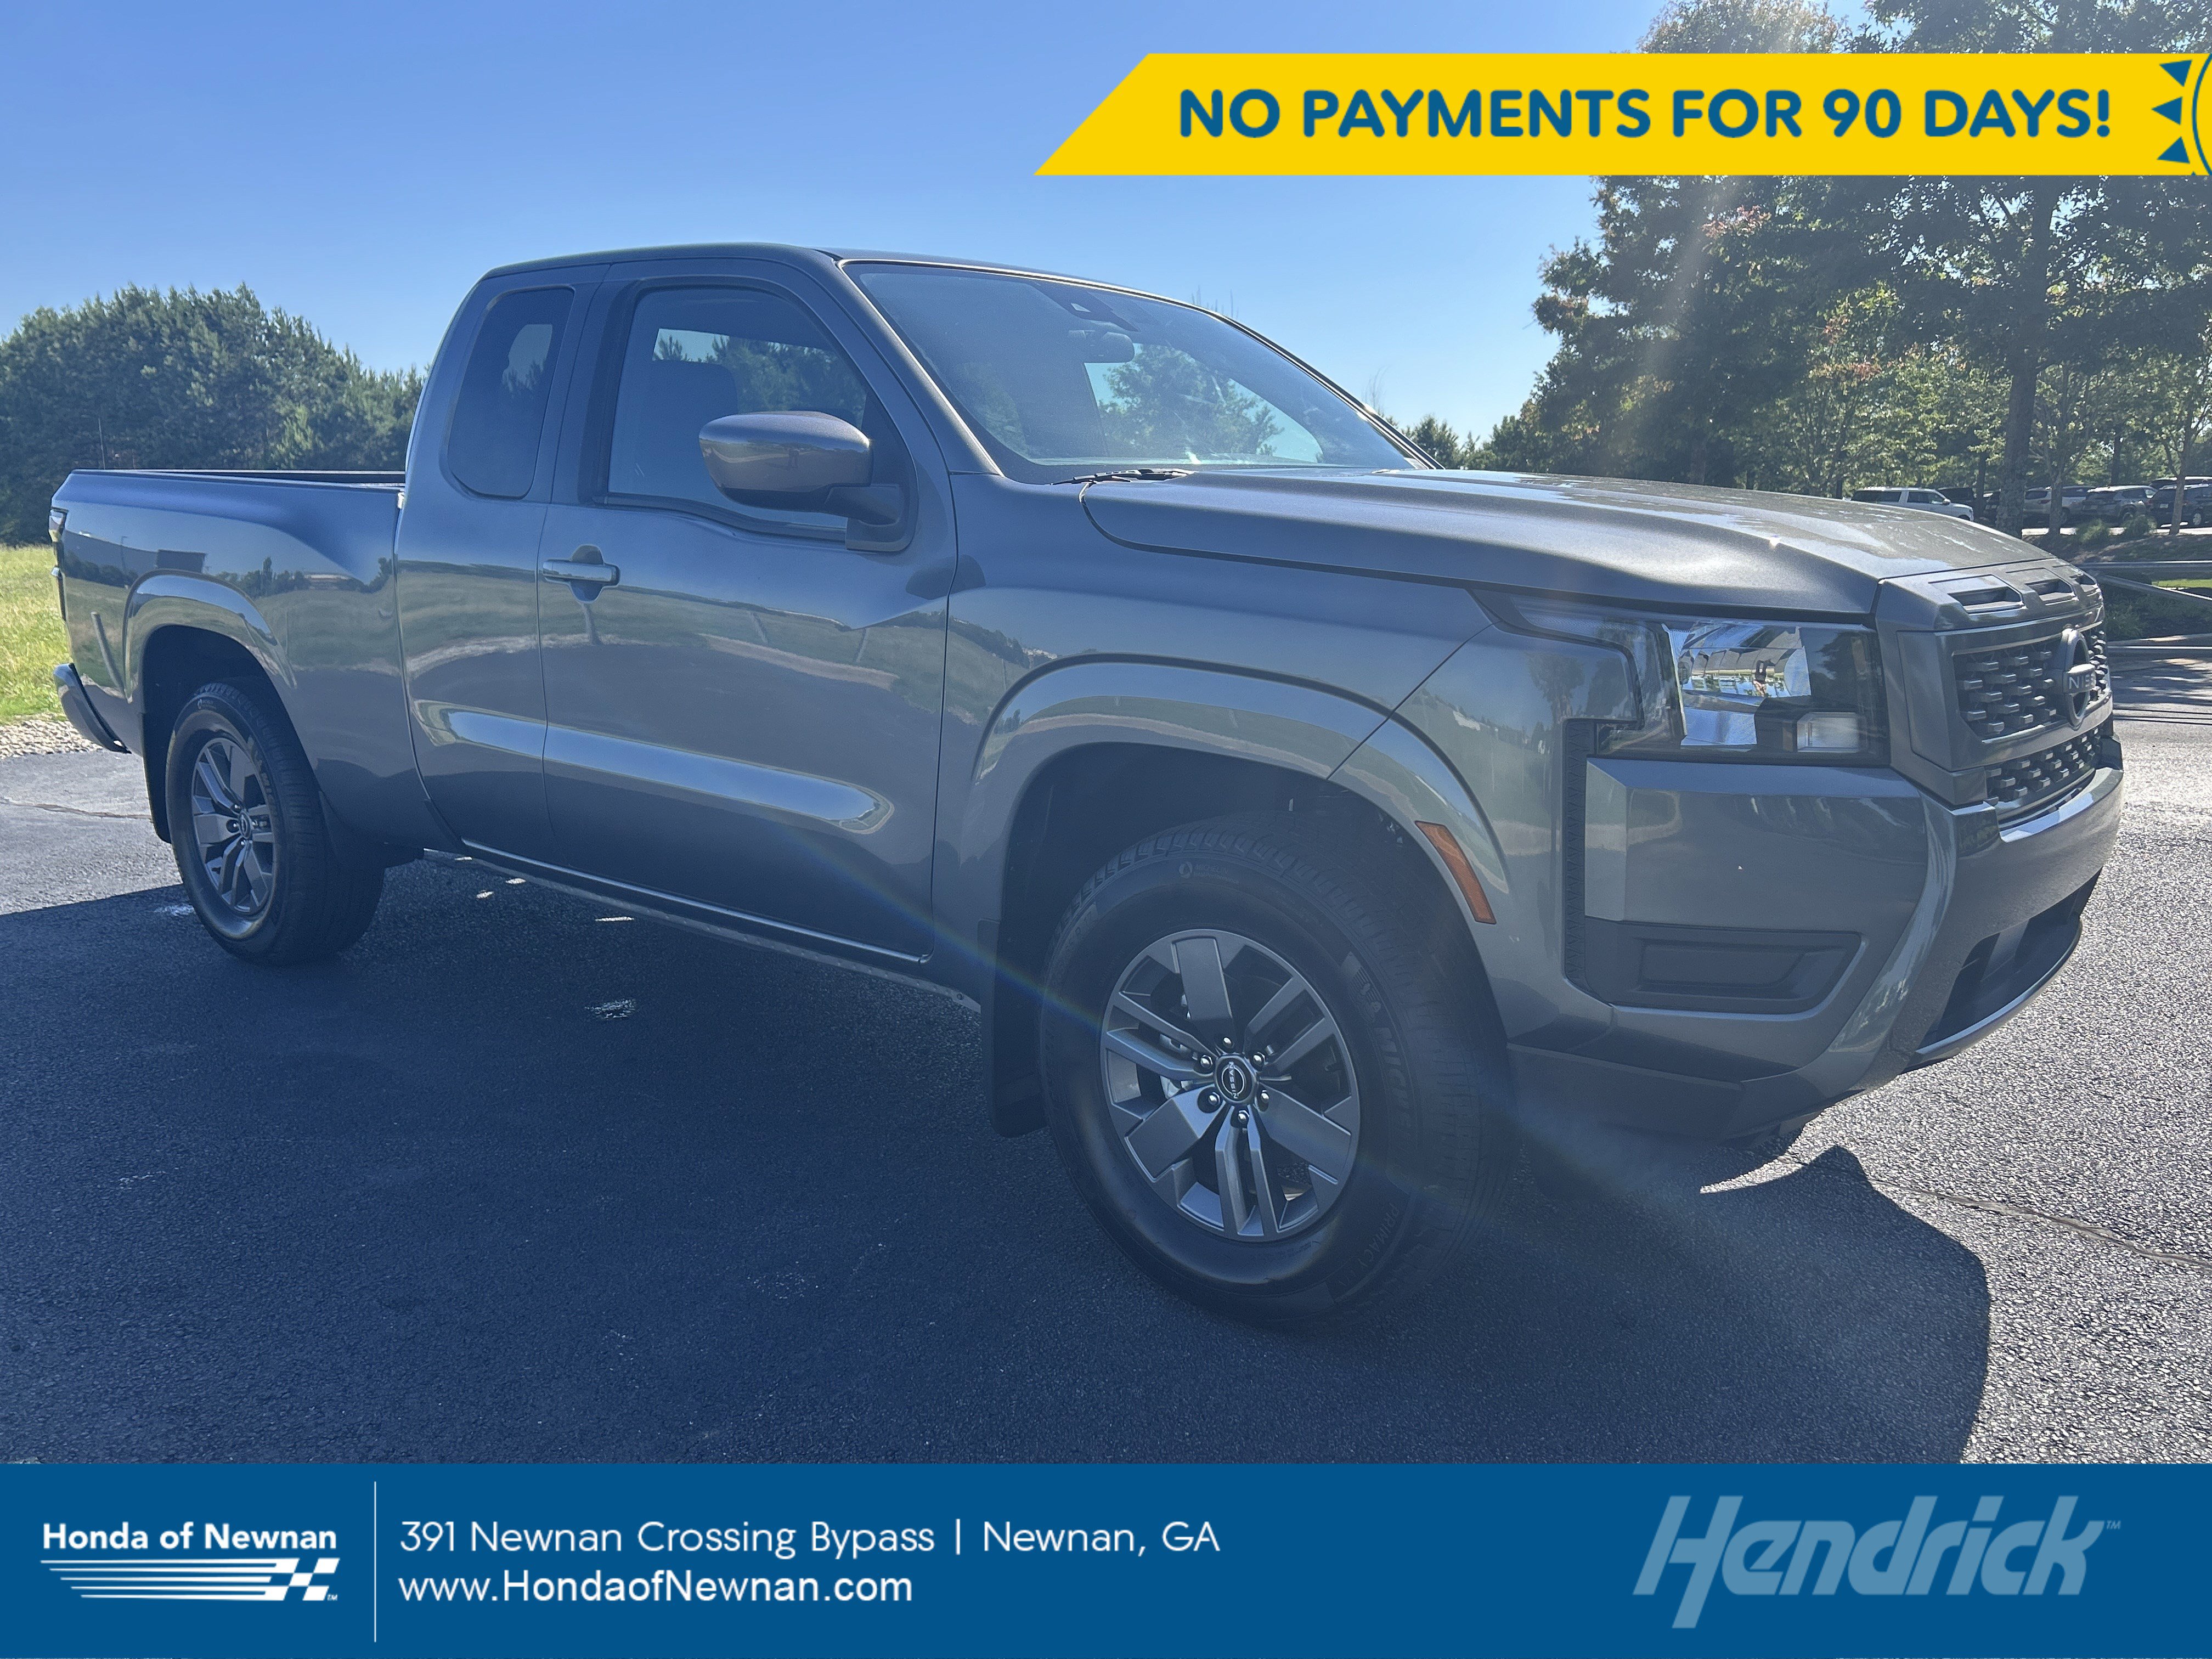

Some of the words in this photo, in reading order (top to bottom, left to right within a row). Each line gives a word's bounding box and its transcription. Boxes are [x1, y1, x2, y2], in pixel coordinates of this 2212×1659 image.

[1228, 1061, 1239, 1099] NISSAN
[1373, 1026, 1412, 1155] MICHE
[1357, 1202, 1400, 1271] PRIMACY
